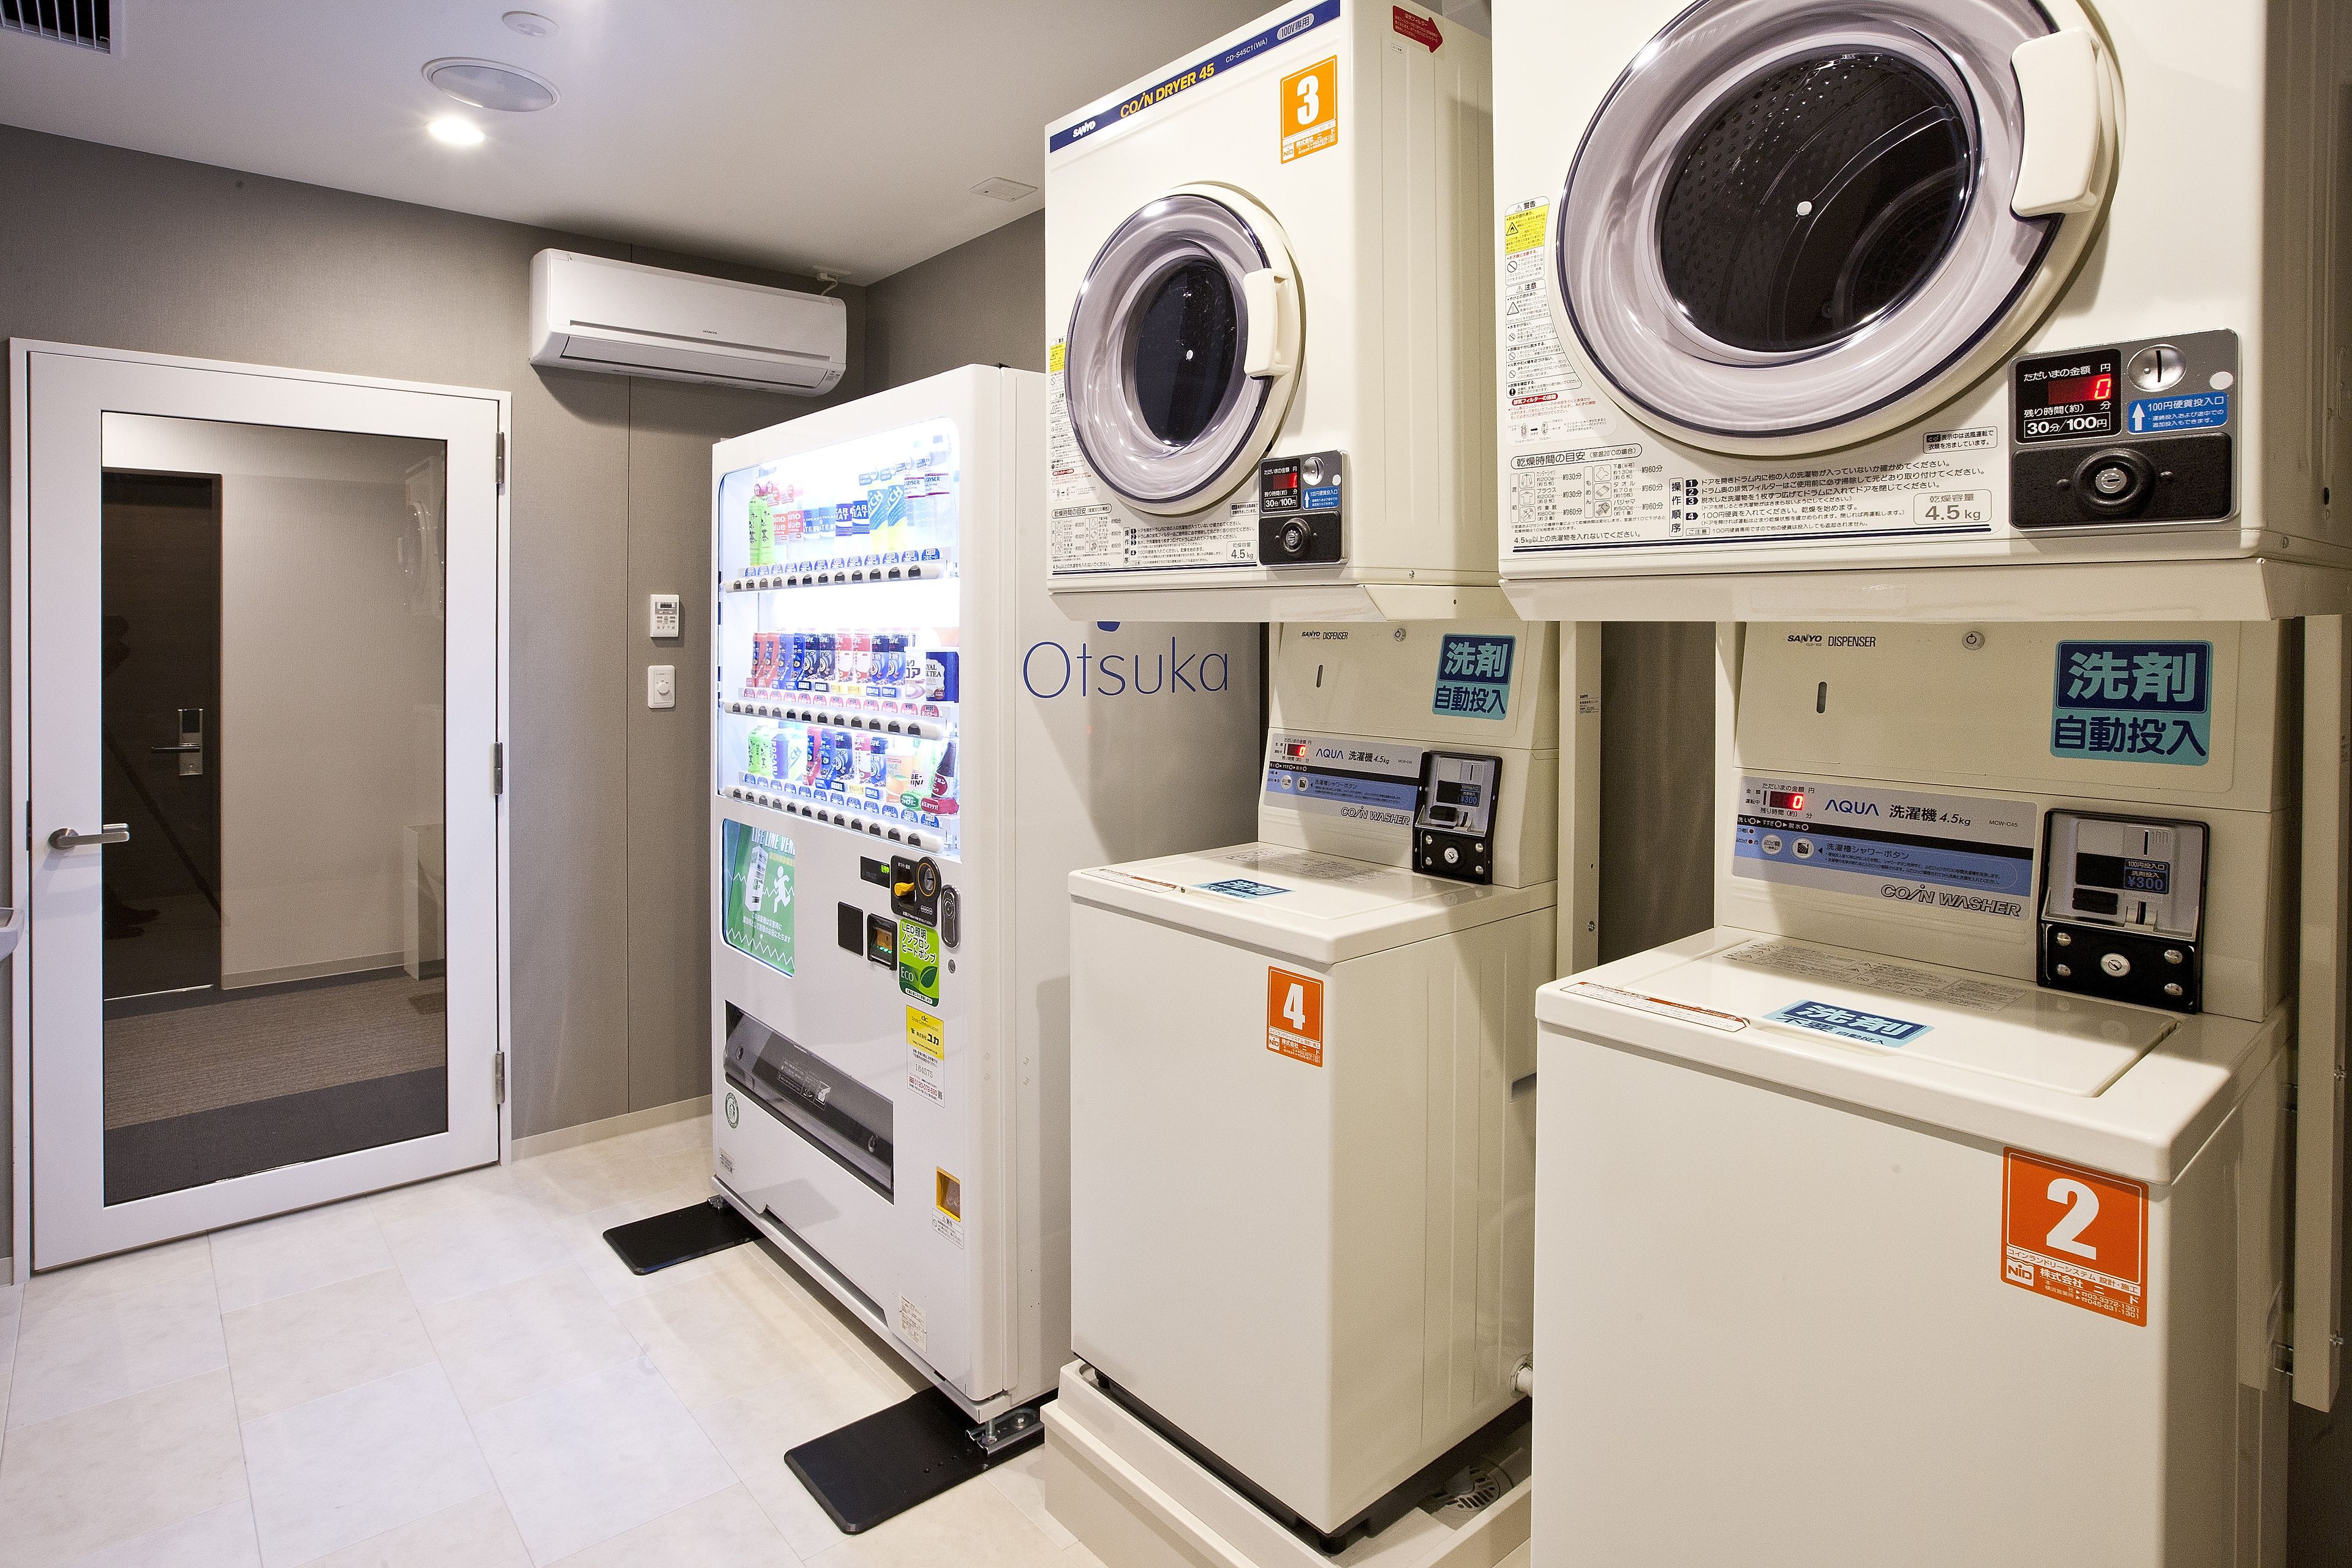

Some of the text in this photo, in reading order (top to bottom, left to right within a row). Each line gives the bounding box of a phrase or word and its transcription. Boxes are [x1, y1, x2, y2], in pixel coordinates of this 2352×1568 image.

[1281, 16, 1310, 37] 100V専用
[1226, 37, 1268, 63] CD-S45C1(WA)
[1120, 62, 1215, 118] COIN DRYER 45
[1297, 75, 1319, 126] 3
[1072, 120, 1096, 138] SANYO
[1525, 282, 1537, 291] 注意
[2024, 366, 2090, 382] ただいまの金額
[2095, 378, 2111, 399] 0
[2024, 401, 2111, 418] 残り時間(約) 分
[2147, 397, 2224, 412] 100円硬貨投入口
[2153, 409, 2224, 421] 連続投入および途中での
[2153, 418, 2214, 428] 追加投入もできます。
[2027, 417, 2107, 435] 30分/100円
[1941, 430, 1994, 440] 表示中は送風運転で
[1929, 440, 1989, 450] 衣類を冷ましています。
[1517, 451, 1586, 467] 乾燥時間の目安
[1562, 472, 1582, 481] 約30分
[1642, 465, 1663, 473] 約60分
[1702, 461, 1950, 485] ドアを開きドラム内に他の人の洗濯物が入っていないか確かめてください。
[1702, 468, 1985, 494] ドラム奥の排気フィルターはご使用前に必ず掃除して元どおり取り付けてください。
[1265, 498, 1296, 508] 30分/100円
[1929, 493, 1975, 503] 乾燥容量
[1563, 508, 1583, 516] 約60分
[1672, 481, 1681, 533] 操作順序
[1925, 505, 1981, 521] 4.5 kg
[1514, 531, 1641, 544] 4.5kg以上の洗濯物を入れないでください。
[1231, 549, 1245, 559] 4.5
[1322, 631, 1348, 640] DISPENSER
[1787, 634, 1876, 647] SANYO DISPENSER
[1023, 636, 1228, 699] Otsuka
[1444, 642, 1508, 677] 洗剤
[2067, 651, 2196, 703] 洗剤
[1434, 685, 1506, 714] 自動投入
[2054, 715, 2207, 757] 自動投入
[1299, 746, 1306, 756] 0
[1316, 748, 1344, 760] AQUA
[1349, 750, 1390, 764] 洗濯機 4.5kg
[1762, 783, 1804, 793] ただいまの金額
[1461, 795, 1477, 805] ¥300
[1792, 795, 1803, 809] 0
[1825, 799, 1879, 816] AQUA
[1341, 805, 1411, 826] COIN WASHER
[1889, 804, 1971, 827] 洗濯機 4.5kg
[752, 827, 794, 856] LIFE LINE VEN
[2152, 831, 2169, 845] 100
[1826, 842, 1909, 859] 洗濯槽シャワーボタン
[2127, 861, 2165, 870] 100円投入口
[1218, 880, 1284, 895] 洗剤
[2127, 876, 2163, 891] ¥300
[1881, 884, 2021, 918] COIN WASHER
[902, 922, 926, 940] LED照明
[902, 934, 929, 950] ノンフロン
[902, 943, 936, 963] ヒートポンプ
[901, 967, 914, 981] ECO
[1283, 982, 1305, 1030] 4
[1776, 1015, 1838, 1033] 不要
[1796, 1005, 1913, 1036] 洗剤
[1837, 1031, 1884, 1045] 自動投入
[2046, 1178, 2100, 1261] 2
[2007, 1248, 2139, 1295] コインランドリーシステム 設計・施工
[2040, 1267, 2083, 1289] 株式会社
[2045, 1285, 2075, 1300] 横浜営業所
[2087, 1298, 2139, 1319] 045-831-1301
